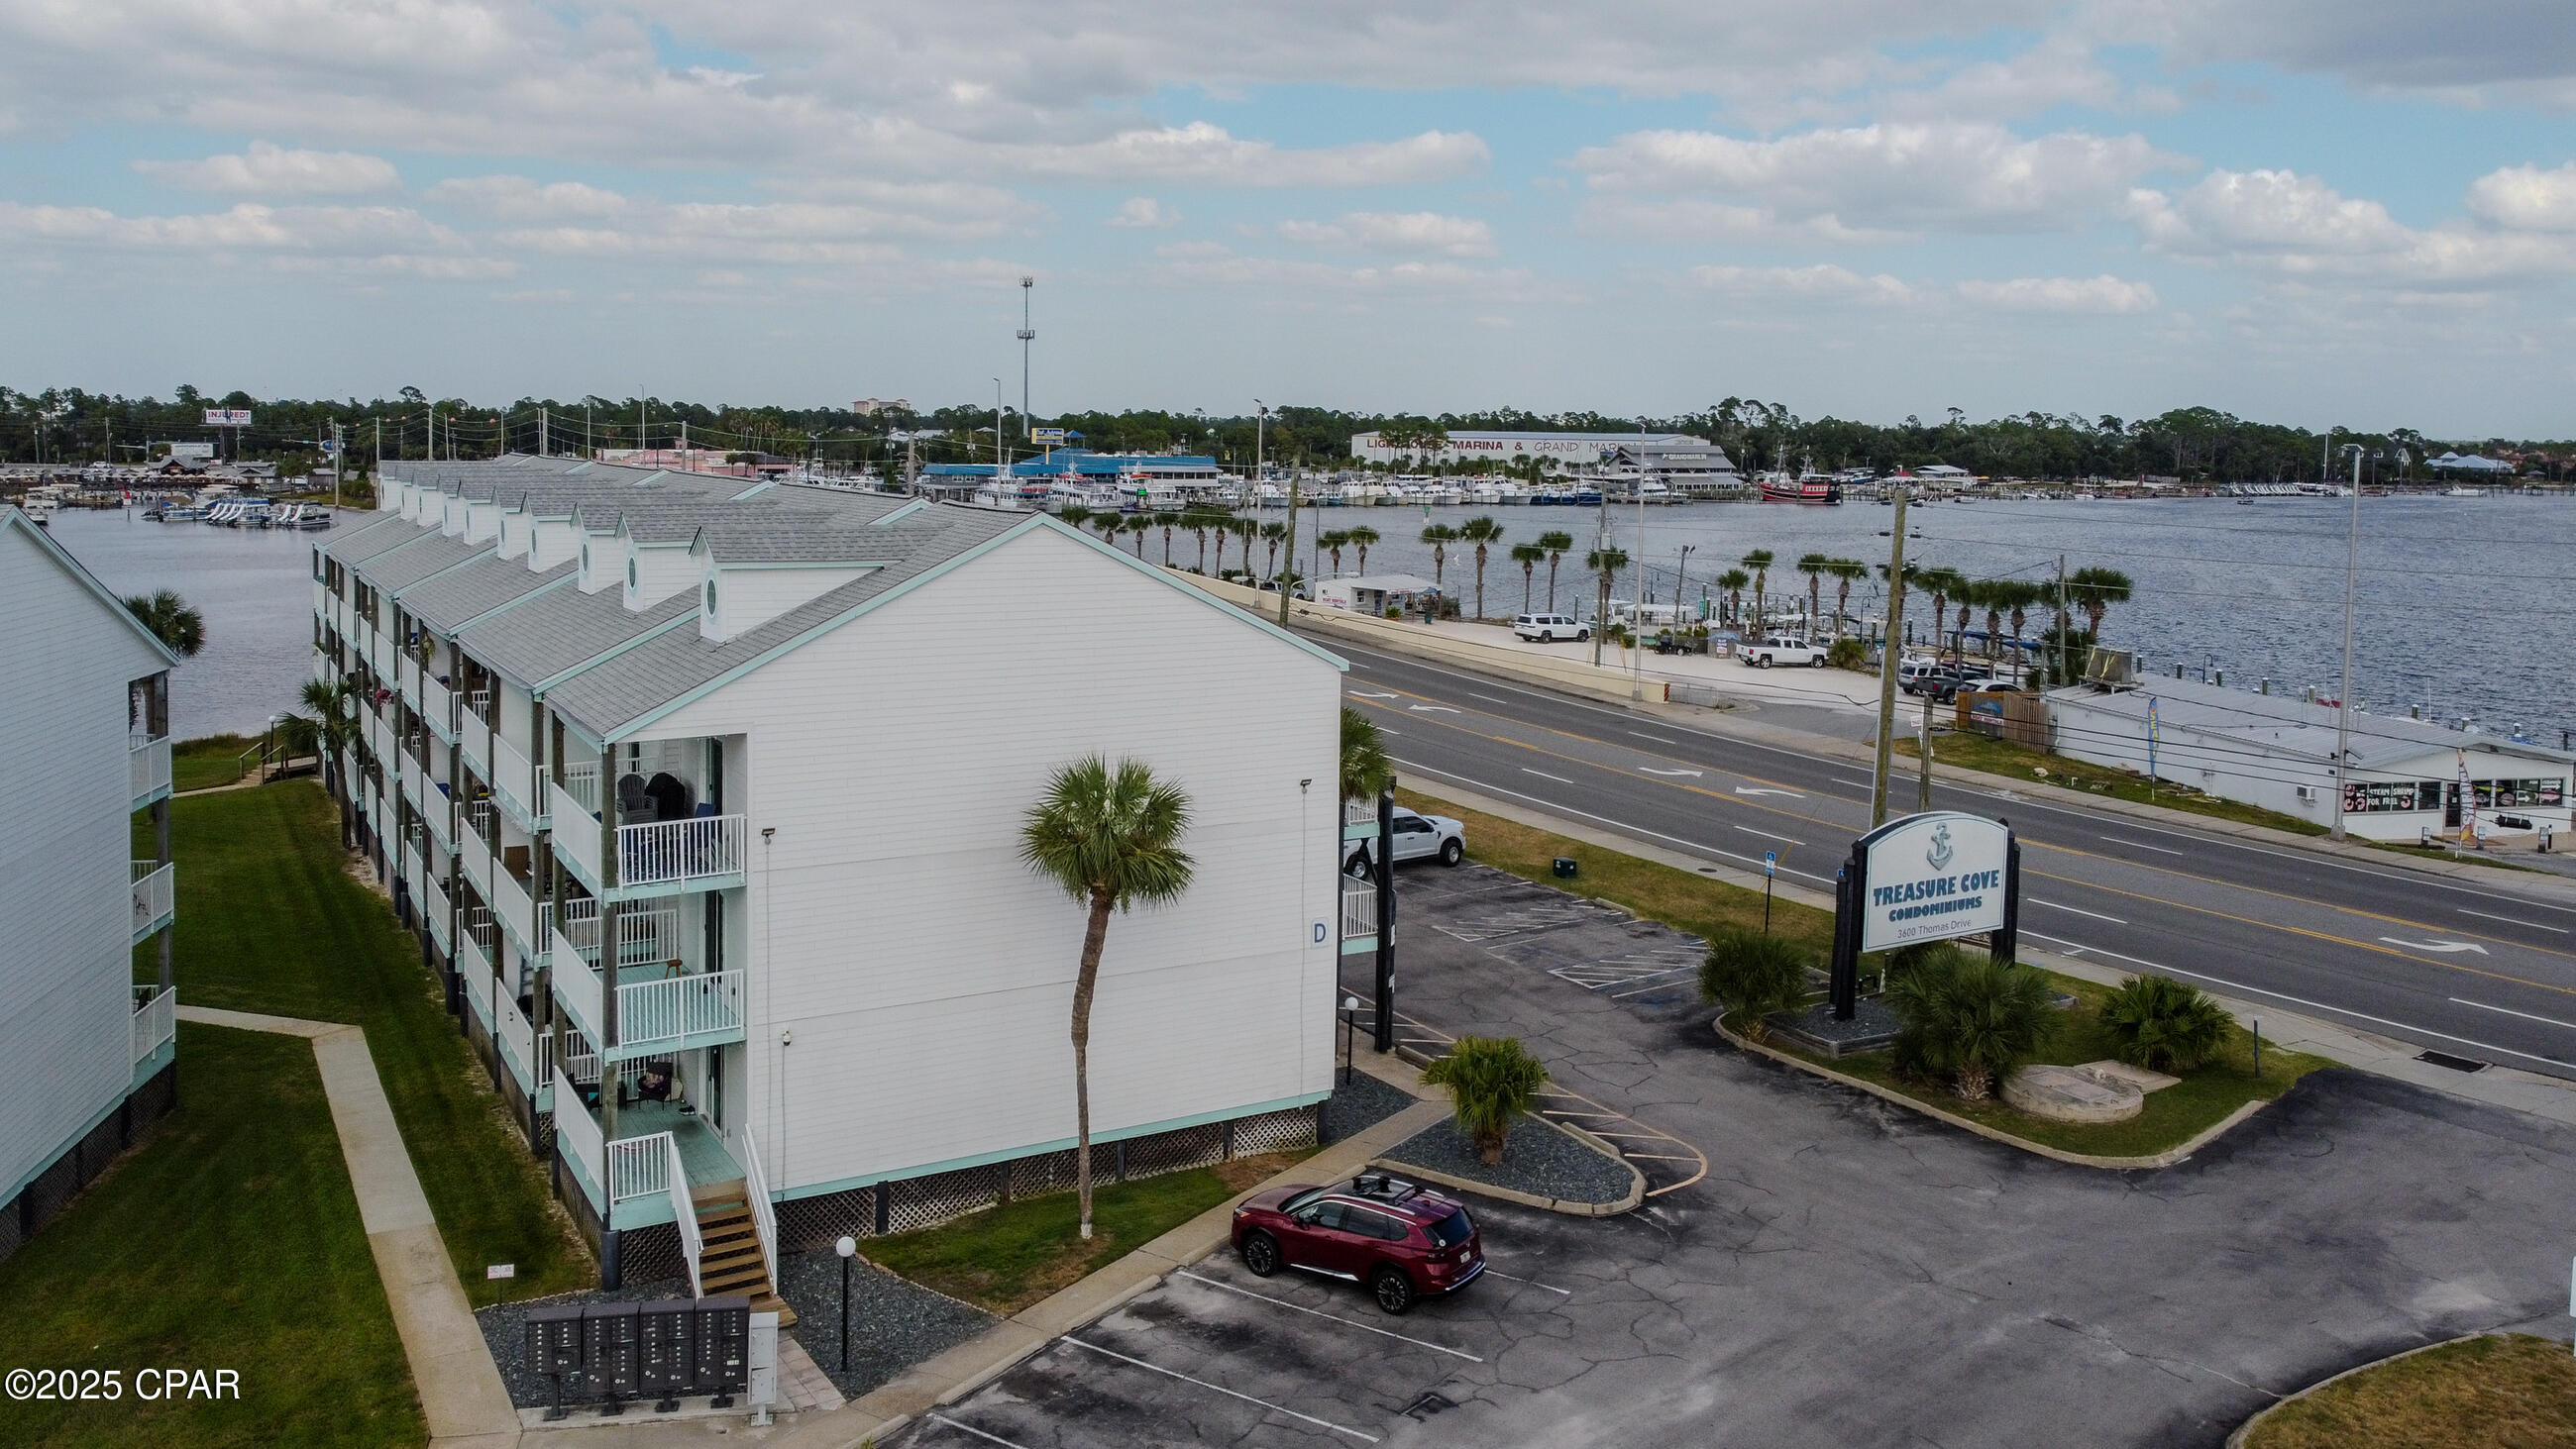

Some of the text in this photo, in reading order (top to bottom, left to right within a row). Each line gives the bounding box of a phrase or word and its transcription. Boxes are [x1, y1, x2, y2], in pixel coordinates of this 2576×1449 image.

[1452, 441, 1503, 450] MARINA
[1515, 442, 1523, 451] &
[1534, 442, 1578, 452] GRAND
[2393, 787, 2415, 796] SHRIMP
[1874, 870, 1999, 906] TREASURE COVE
[1888, 896, 1983, 922] CONDOMINIUMS
[1315, 923, 1327, 943] D
[1897, 919, 1972, 939] 3600 Thomas Drive
